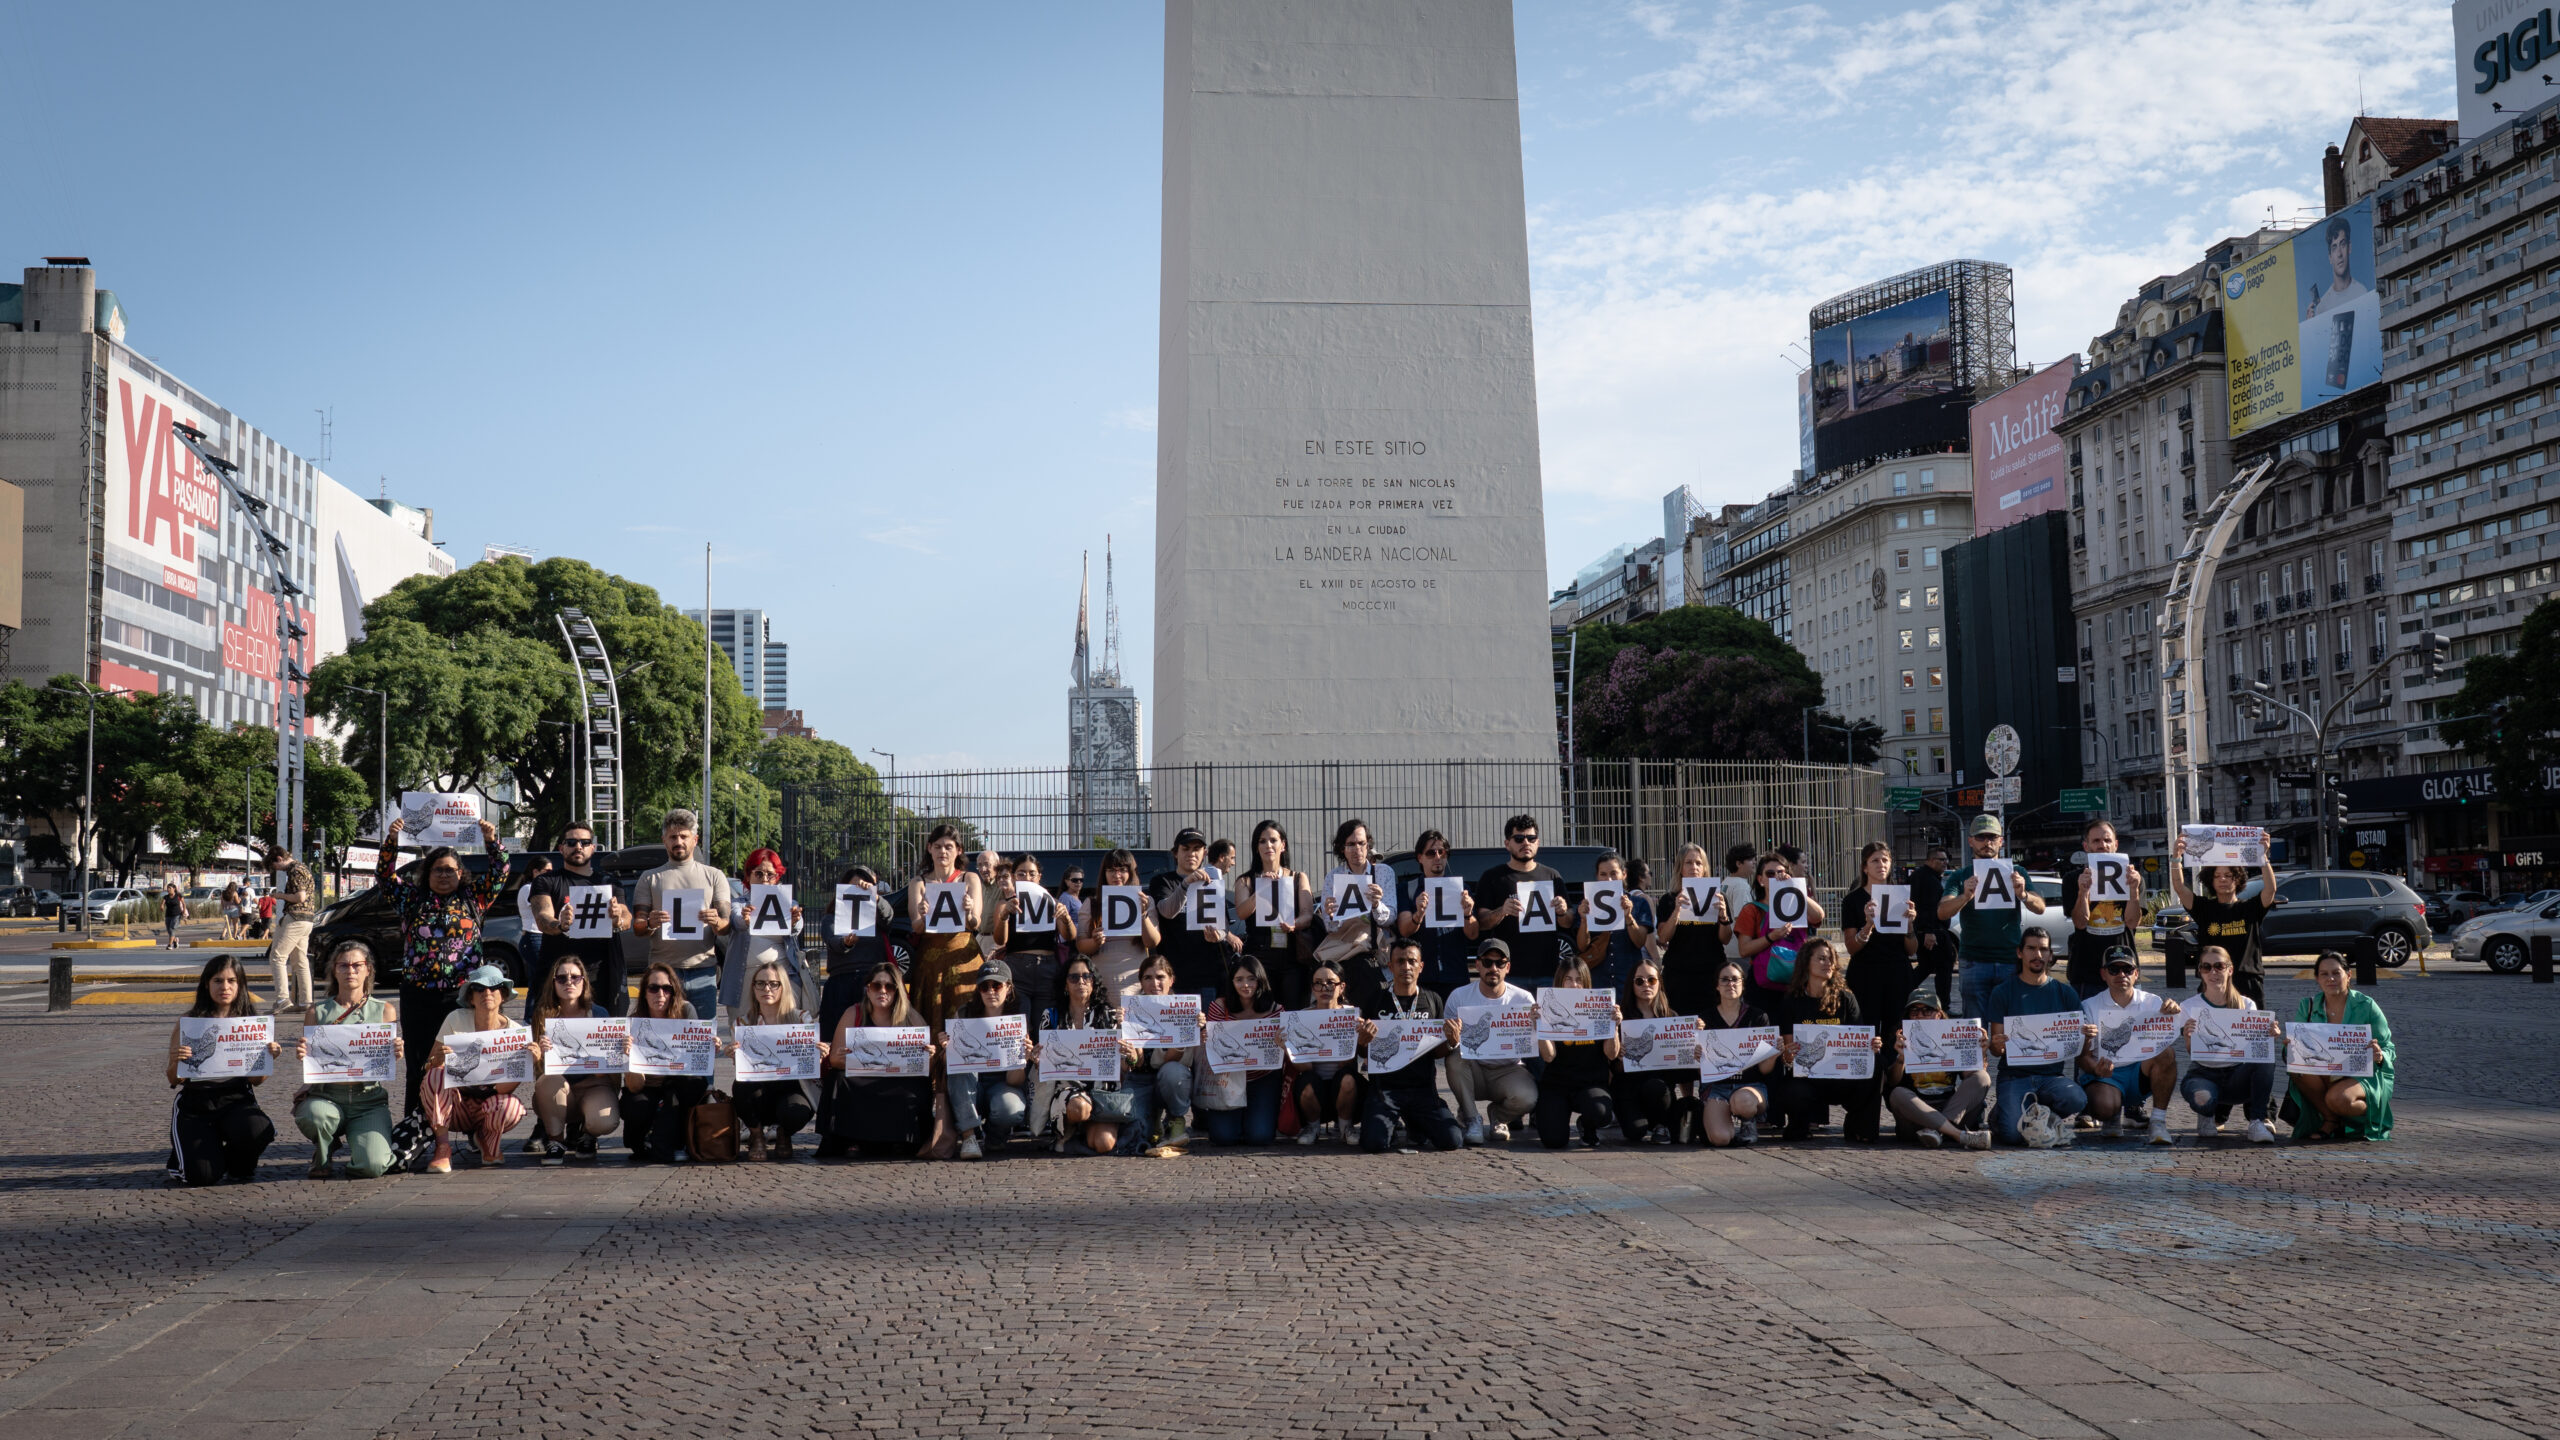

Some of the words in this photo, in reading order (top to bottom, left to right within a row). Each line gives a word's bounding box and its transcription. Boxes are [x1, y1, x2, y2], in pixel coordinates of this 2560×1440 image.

[2476, 0, 2529, 32] UNIV
[2474, 8, 2560, 94] SIGL
[2246, 254, 2276, 278] mercado
[2246, 274, 2264, 292] pago
[2231, 359, 2242, 374] Te
[2244, 353, 2258, 368] soy
[2260, 340, 2291, 361] franco,
[2232, 372, 2250, 390] esta
[2252, 360, 2280, 381] tarjeta
[2282, 353, 2294, 368] de
[2232, 384, 2262, 405] crédito
[2264, 379, 2274, 392] es
[2233, 400, 2257, 424] gratis
[2260, 391, 2284, 414] posta
[1990, 390, 2060, 460] Medifé
[1305, 440, 1325, 455] EN
[1335, 440, 1374, 455] ESTE
[1385, 440, 1426, 455] SITIO
[118, 377, 196, 563] YA!
[1276, 478, 1289, 488] EN
[1296, 478, 1310, 488] LA
[1317, 478, 1353, 488] TORRE
[1363, 478, 1376, 488] DE
[1383, 478, 1402, 488] SAN
[1410, 478, 1455, 488] NICOLAS
[174, 476, 217, 525] PASANDO
[1283, 500, 1304, 510] FUE
[1311, 500, 1342, 510] IZADA
[1350, 500, 1372, 510] POR
[1379, 500, 1424, 510] PRIMERA
[1432, 500, 1453, 510] VEZ
[1327, 526, 1341, 535] EN
[1348, 526, 1361, 535] LA
[1368, 526, 1406, 535] CIUDAD
[1275, 547, 1294, 561] LA
[1304, 547, 1372, 561] BANDERA
[1381, 547, 1457, 561] NACIONAL
[164, 570, 177, 587] OBRA
[177, 574, 196, 594] INICIADA
[1300, 580, 1312, 588] EL
[1321, 580, 1343, 588] XXIII
[1350, 580, 1364, 588] DE
[1371, 580, 1416, 588] AGOSTO
[1423, 580, 1436, 588] DE
[1342, 601, 1396, 610] MDCCCXII
[225, 628, 243, 668] SE
[2422, 773, 2496, 800] GLOALE
[2356, 830, 2384, 848] TOSTADO
[1978, 868, 2012, 903] A
[2097, 861, 2126, 894] R
[575, 894, 606, 929] #
[673, 898, 696, 933] L
[753, 894, 788, 929] A
[843, 894, 870, 930] T
[929, 891, 962, 926] A
[1018, 892, 1055, 924] M
[1108, 894, 1138, 929] D
[1197, 889, 1217, 924] E
[1264, 881, 1278, 921] J
[1337, 884, 1367, 916] A
[1435, 887, 1457, 921] L
[1522, 891, 1552, 926] A
[1593, 890, 1617, 925] S
[1687, 886, 1717, 916] V
[1773, 887, 1806, 922] O
[1880, 894, 1901, 927] L
[231, 1024, 266, 1033] LATAM
[1501, 1012, 1530, 1020] LATAM
[1664, 1023, 1694, 1032] LATAM
[217, 1033, 267, 1042] AIRLINES:
[349, 1039, 391, 1047] AIRLINES:
[481, 1044, 528, 1055] AIRLINES:
[493, 1035, 526, 1044] LATAM
[986, 1030, 1023, 1038] AIRLINES:
[1244, 1031, 1277, 1039] AIRLINE
[1654, 1032, 1695, 1040] AIRLINES:
[1748, 1034, 1775, 1042] LATAM
